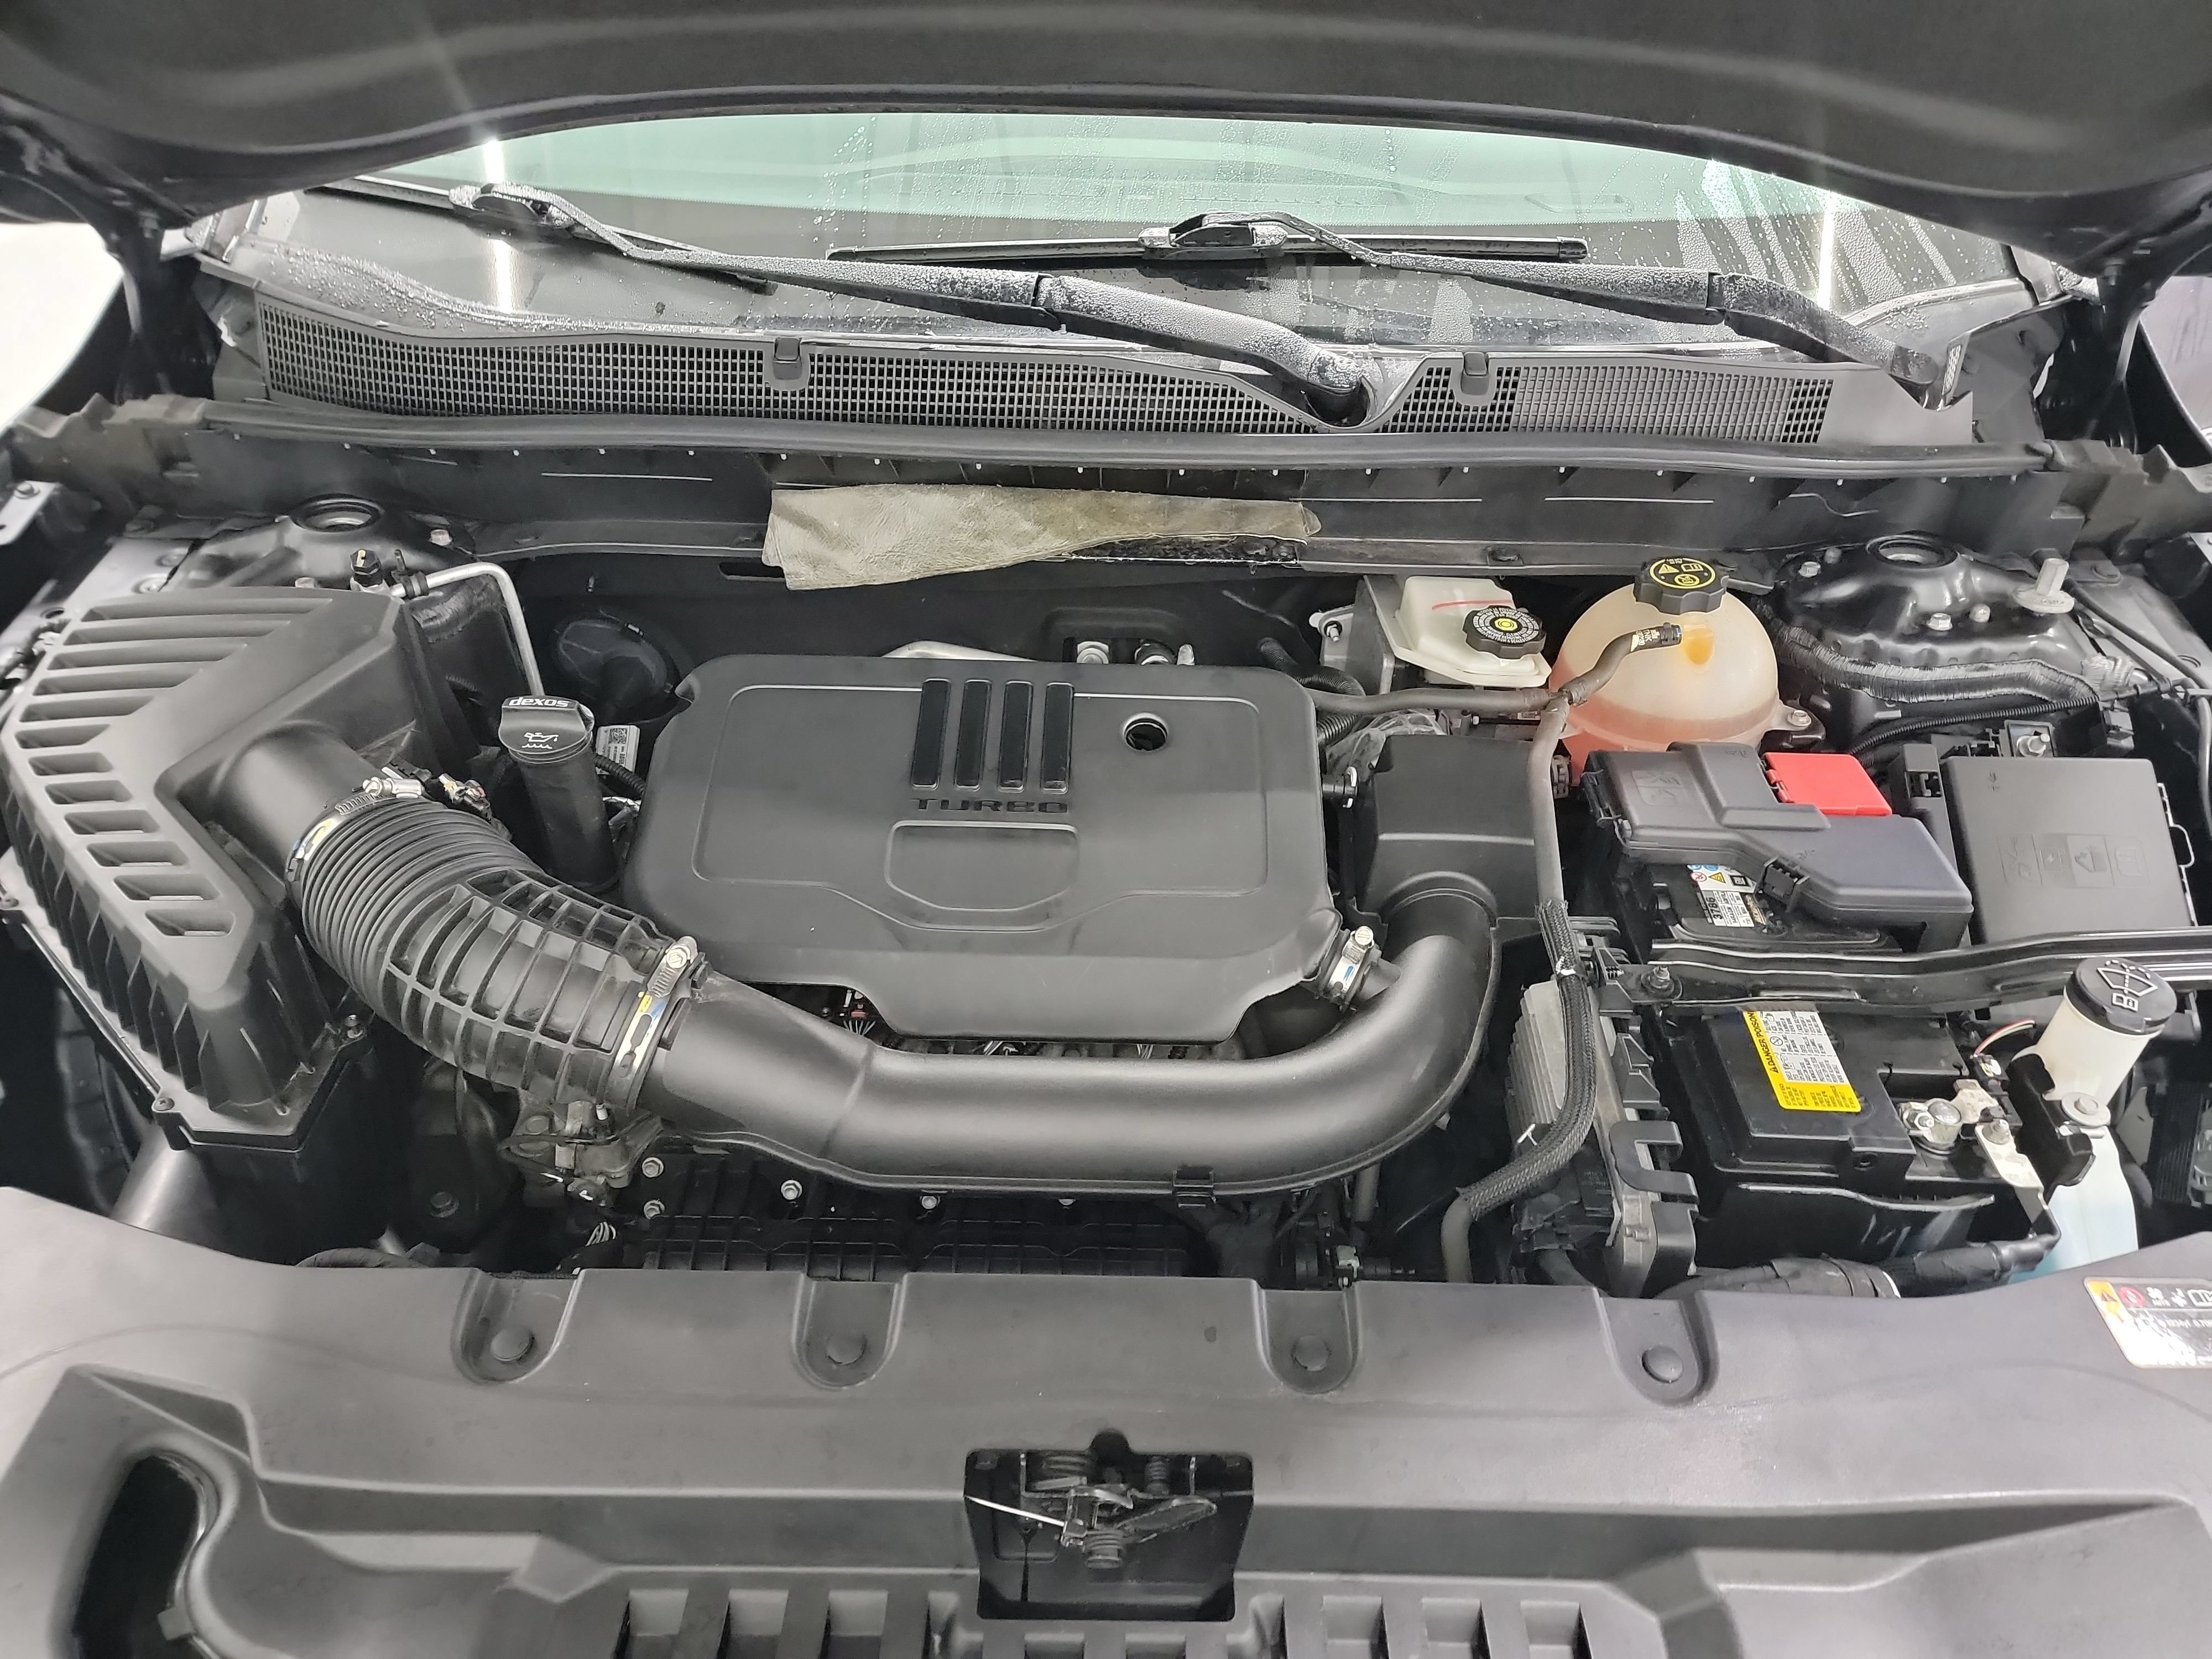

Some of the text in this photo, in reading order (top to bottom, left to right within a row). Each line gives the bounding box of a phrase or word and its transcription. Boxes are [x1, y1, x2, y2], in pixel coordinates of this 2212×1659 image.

[509, 697, 570, 707] dexos
[909, 799, 1068, 813] TURBO
[1706, 897, 1723, 920] 3786
